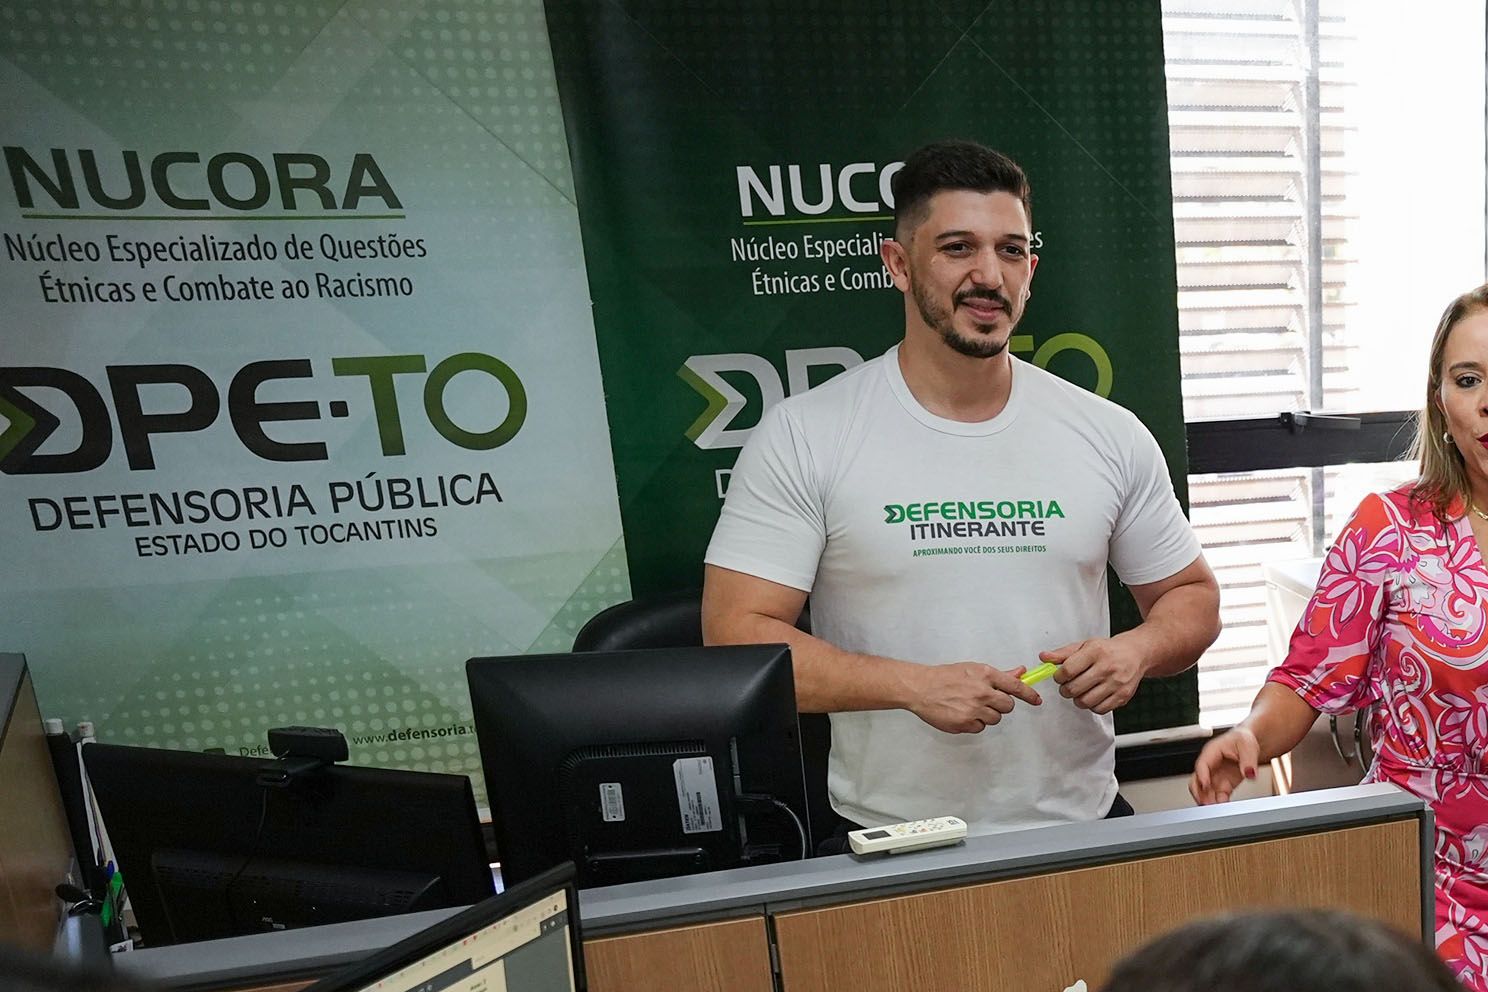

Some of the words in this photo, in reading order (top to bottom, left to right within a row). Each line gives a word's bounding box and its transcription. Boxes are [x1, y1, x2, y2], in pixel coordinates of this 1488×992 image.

[3, 146, 404, 211] NUCORA
[736, 161, 906, 217] NUC
[4, 233, 100, 262] Núcleo
[106, 233, 277, 268] Especializado
[284, 233, 314, 260] de
[319, 233, 427, 262] Questões
[731, 236, 799, 262] Núcleo
[803, 232, 894, 263] Especiali
[39, 270, 136, 303] Étnicas
[142, 282, 157, 302] e
[163, 273, 274, 302] Combate
[281, 278, 310, 299] ao
[315, 272, 413, 299] Racismo
[752, 267, 820, 296] Étnicas
[825, 273, 836, 291] e
[840, 265, 894, 291] Comb
[28, 483, 317, 532] DEFENSORIA
[328, 471, 503, 514] PÚBLICA
[884, 500, 1066, 524] DEFENSORIA
[134, 530, 241, 557] ESTADO
[249, 527, 287, 550] DO
[294, 517, 438, 545] TOCANTINS
[910, 521, 1046, 540] ITINERANTE
[912, 546, 963, 558] APROXIMANDO
[964, 545, 981, 554] VOCÊ
[982, 545, 996, 554] DOS
[997, 545, 1014, 554] SEUS
[1015, 544, 1047, 553] DIREITOS
